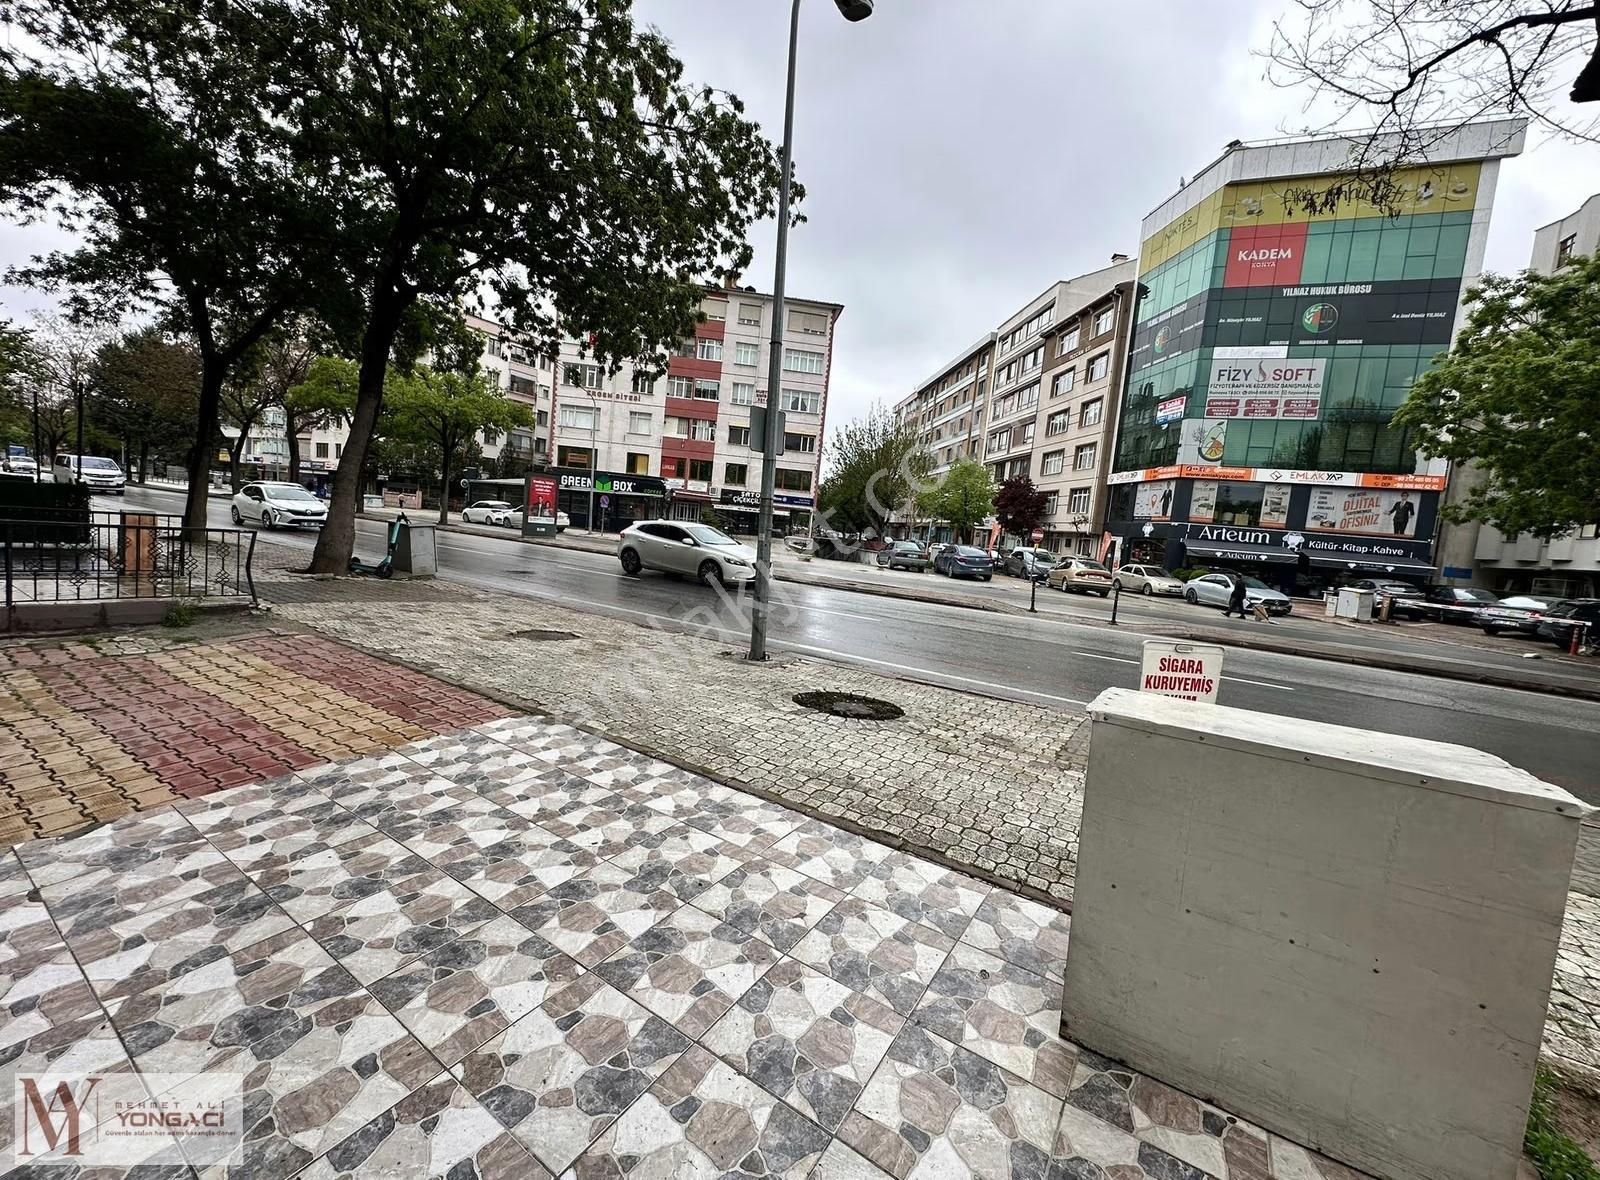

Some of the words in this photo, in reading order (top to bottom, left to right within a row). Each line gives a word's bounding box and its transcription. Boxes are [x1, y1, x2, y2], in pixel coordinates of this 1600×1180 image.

[1238, 248, 1292, 262] KADEM
[1282, 287, 1309, 297] YILMAZ
[1310, 286, 1337, 296] HUKUK
[1338, 284, 1372, 294] BÜROSU
[1217, 366, 1252, 381] FİZY
[1272, 368, 1316, 381] SOFT
[561, 475, 591, 488] GREEN
[613, 480, 633, 492] BOX
[1185, 472, 1245, 480] www.emlakyap.com
[1343, 495, 1381, 511] DİJİTAL
[1340, 513, 1380, 529] OFİSİNİZ
[1199, 525, 1270, 543] Arteum
[1224, 551, 1257, 560] Arteum
[1308, 540, 1338, 551] Kültür
[1343, 543, 1368, 554] Kitap
[1372, 545, 1404, 556] Kahve
[1159, 655, 1203, 674] SİGARA
[1145, 675, 1213, 694] KURUYEMİŞ
